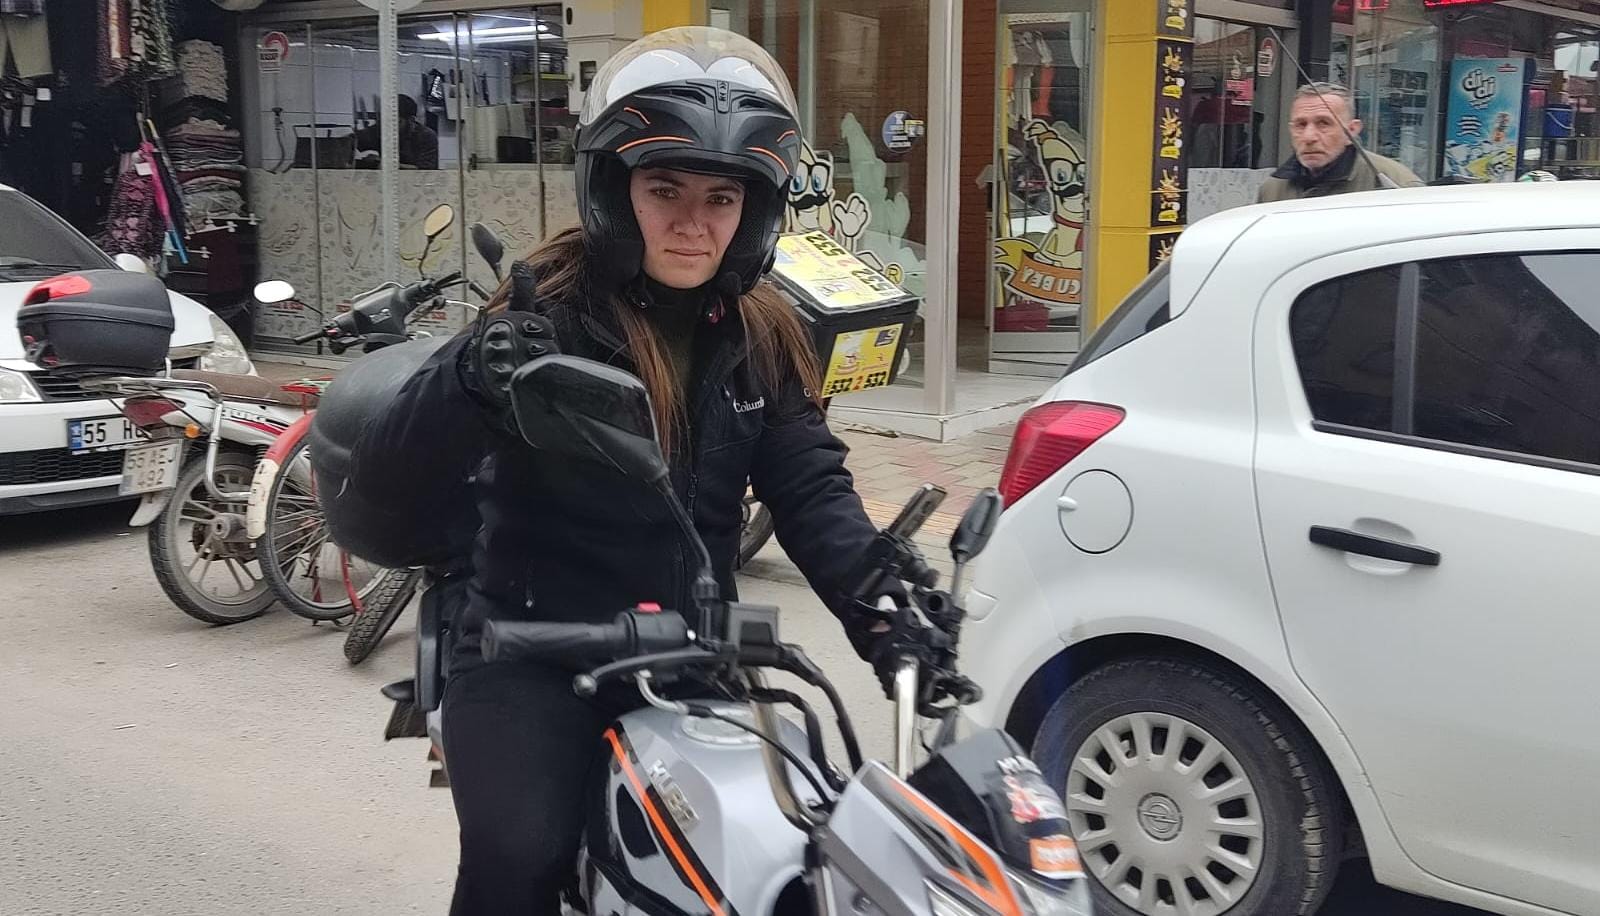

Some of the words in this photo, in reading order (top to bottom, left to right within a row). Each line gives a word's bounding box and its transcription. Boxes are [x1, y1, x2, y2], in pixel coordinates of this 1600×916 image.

[805, 234, 847, 257] 532
[829, 377, 852, 395] 532
[852, 375, 863, 390] 2
[864, 371, 887, 389] 532
[84, 422, 106, 444] 55
[127, 451, 146, 469] 55
